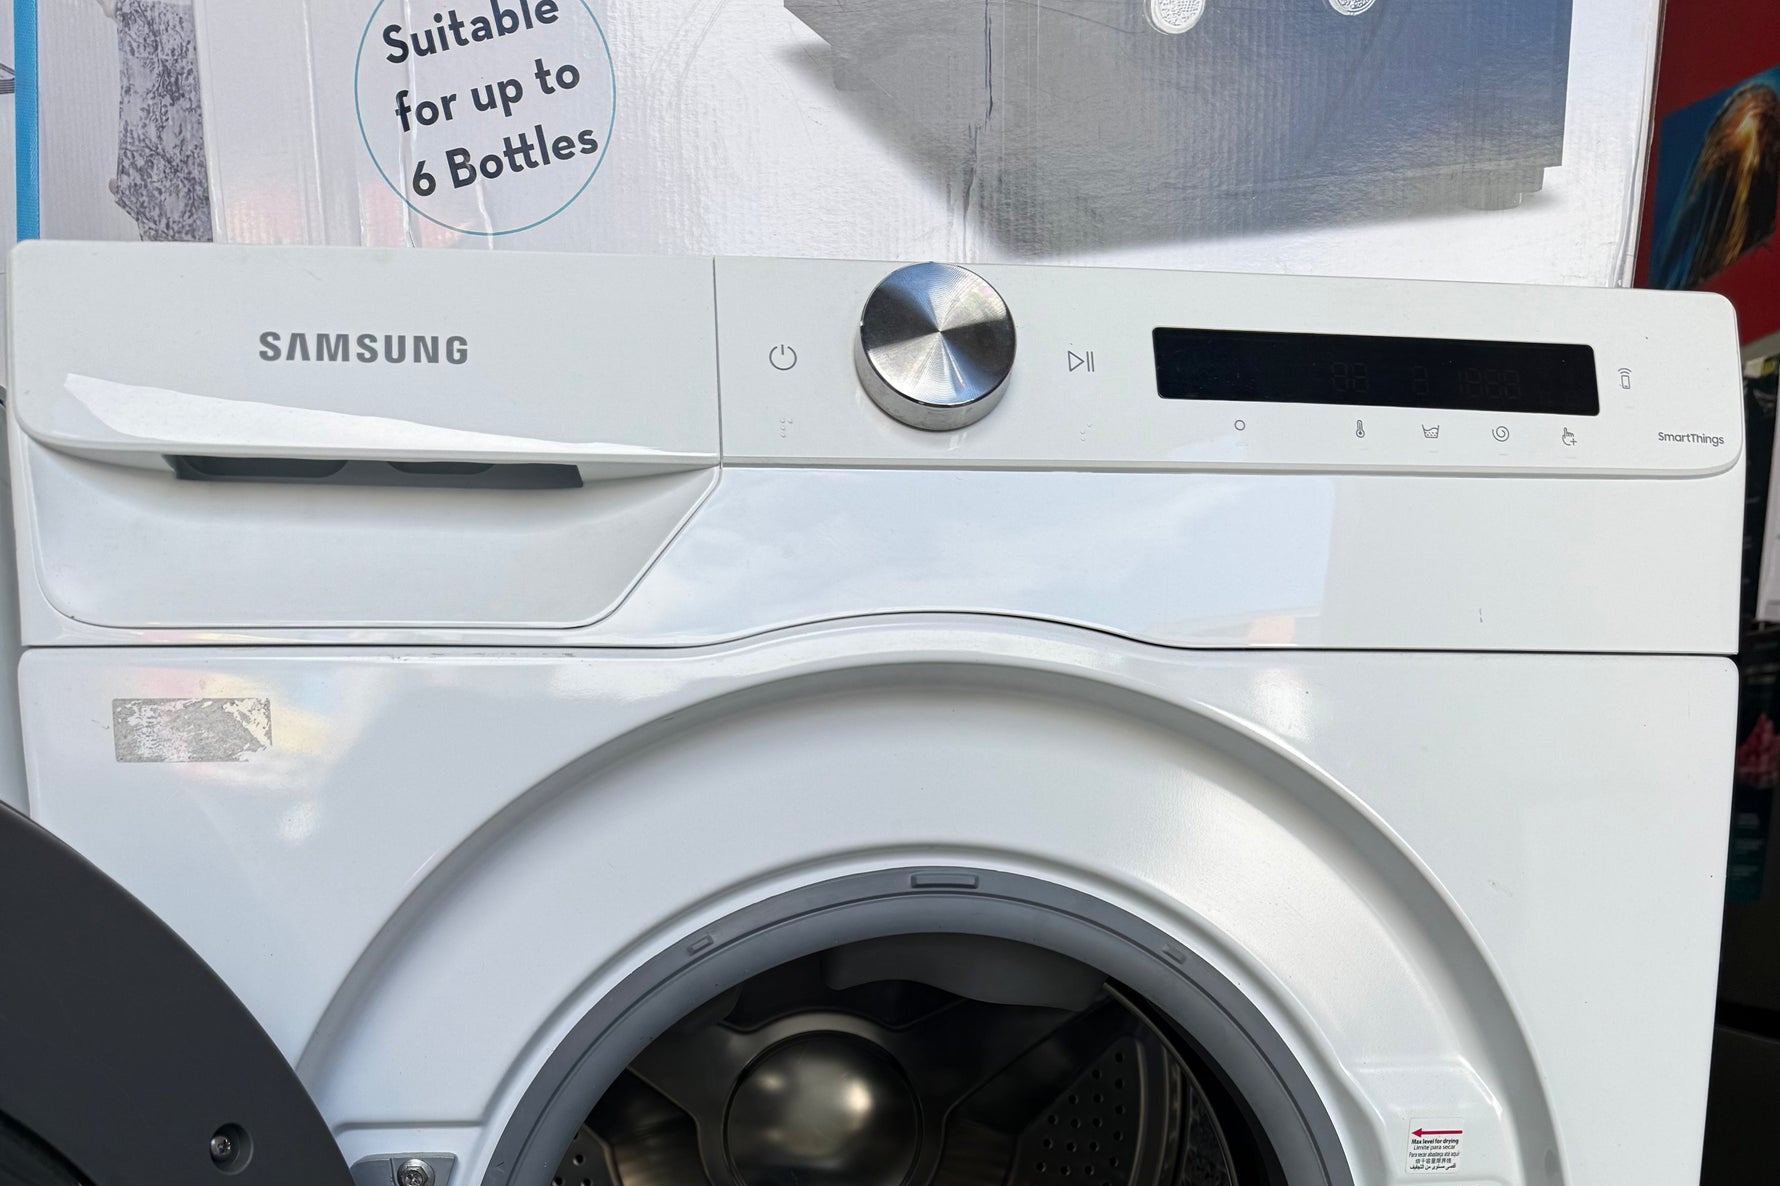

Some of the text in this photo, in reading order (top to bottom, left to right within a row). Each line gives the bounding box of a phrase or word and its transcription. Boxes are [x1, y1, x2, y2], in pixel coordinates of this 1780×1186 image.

[382, 0, 560, 64] Suitable
[394, 58, 581, 133] for up to
[412, 124, 599, 197] 6 Bottles
[258, 331, 469, 365] SAMSUNG
[1657, 431, 1725, 448] SmartThings
